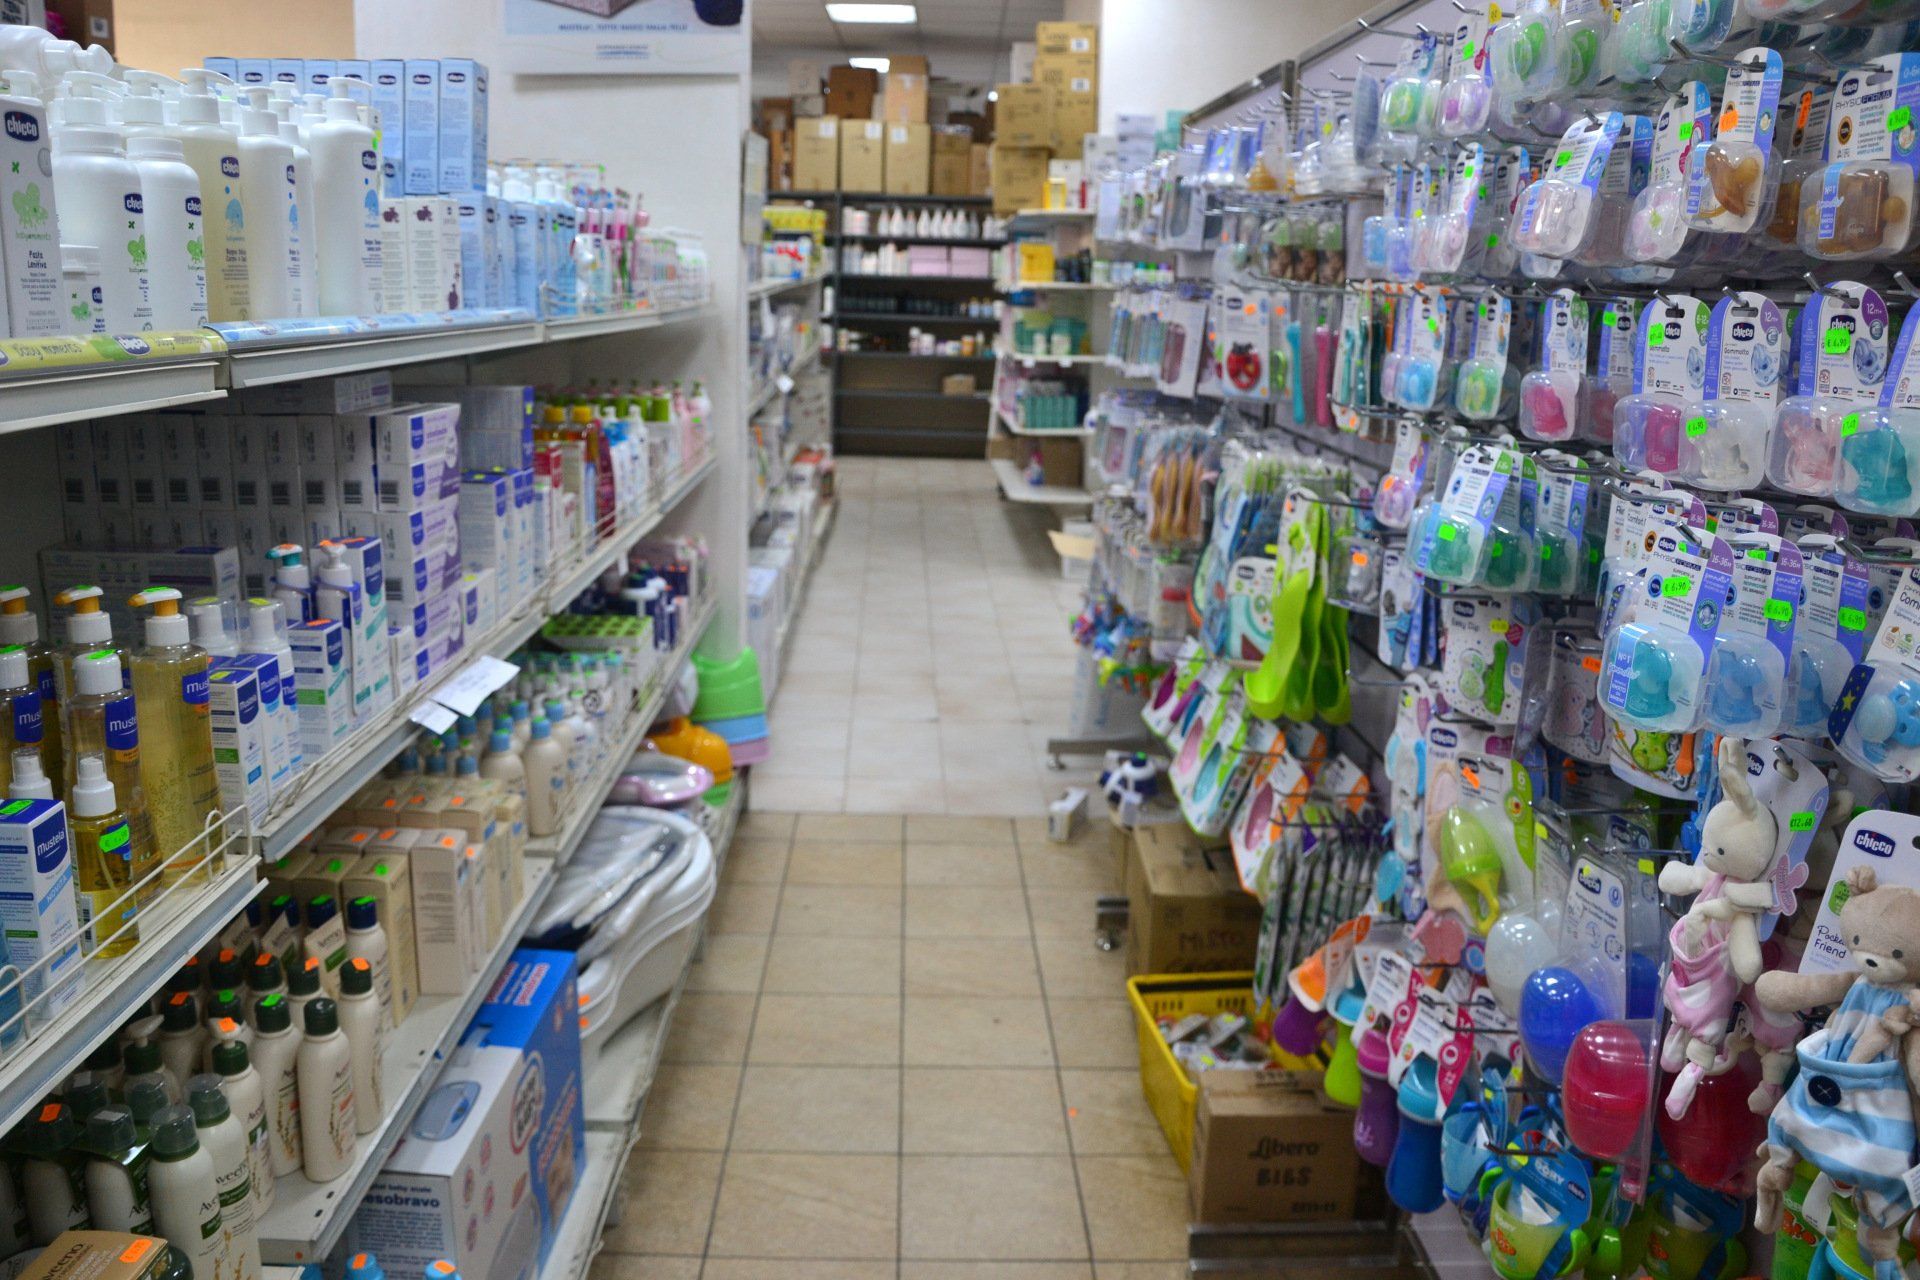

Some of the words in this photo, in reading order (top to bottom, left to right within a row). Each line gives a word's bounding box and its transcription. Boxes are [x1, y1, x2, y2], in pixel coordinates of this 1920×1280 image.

[7, 115, 37, 137] chicco
[1733, 324, 1753, 338] chicco
[1856, 834, 1893, 855] chicco
[1817, 925, 1847, 946] Pocke
[1814, 939, 1847, 959] Friend
